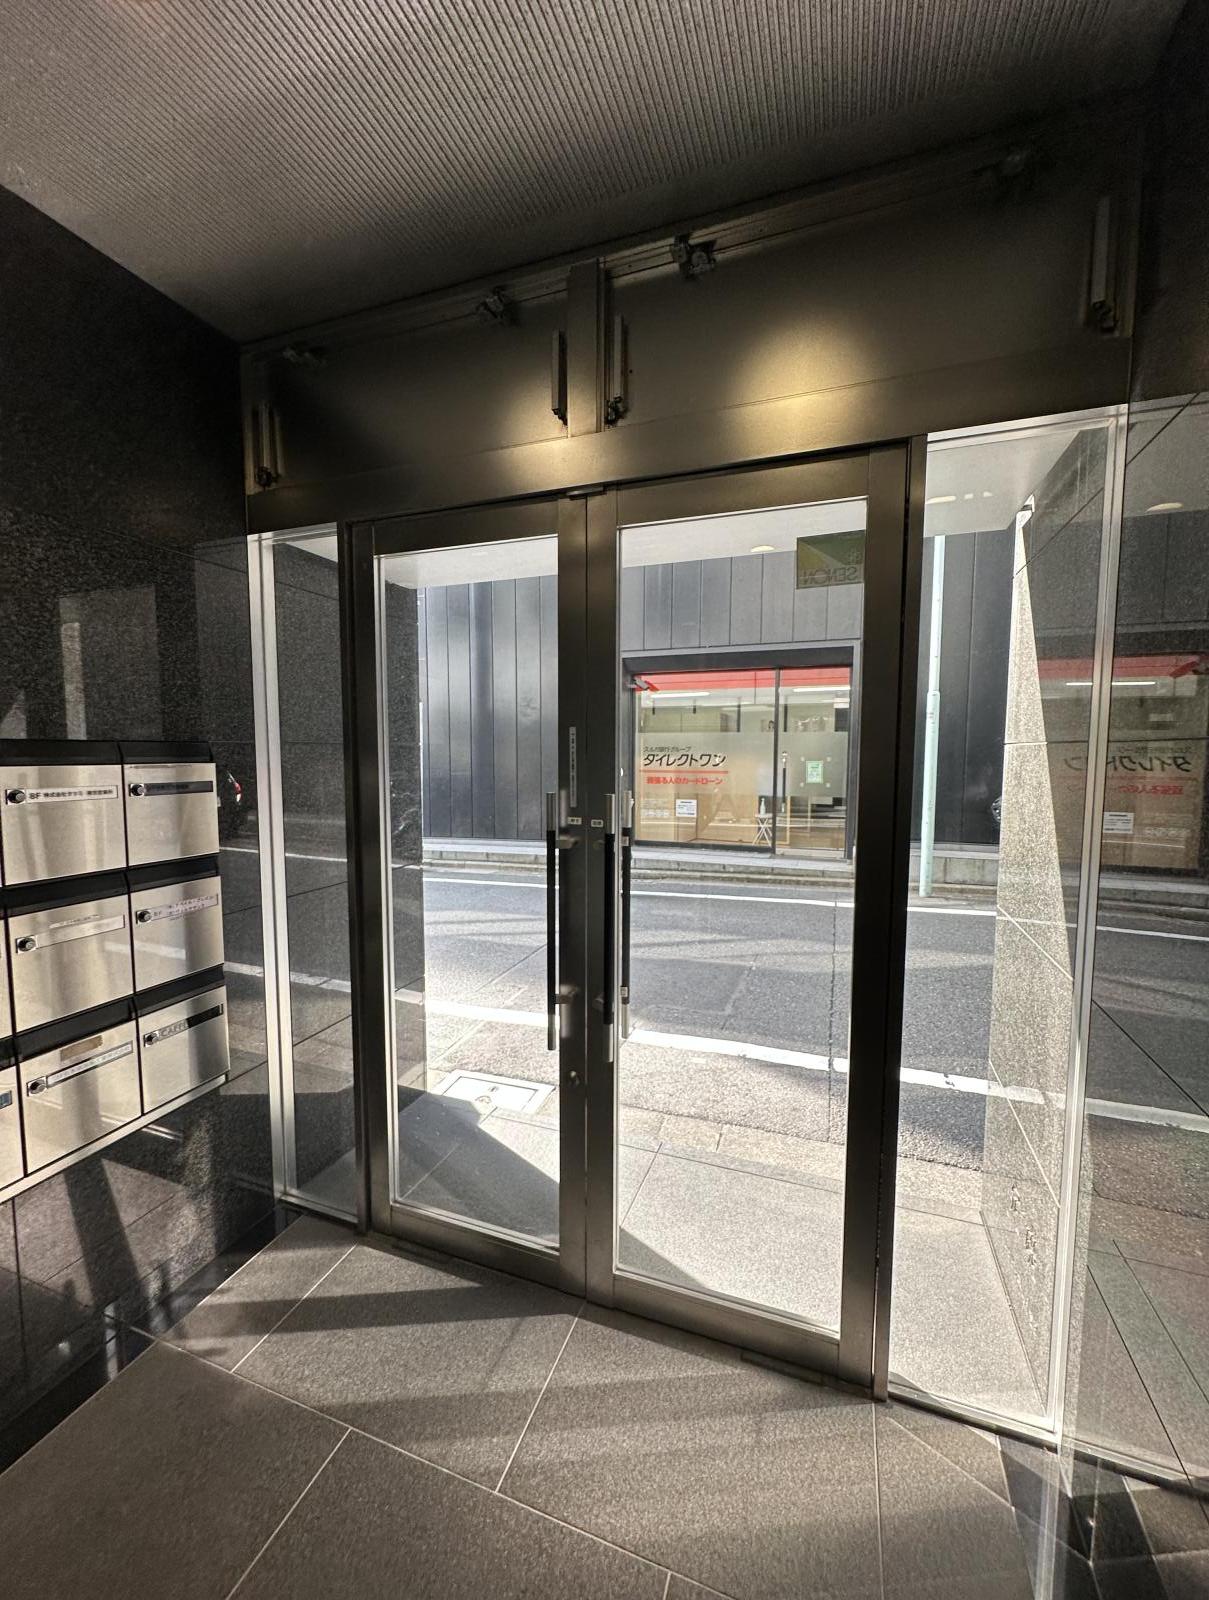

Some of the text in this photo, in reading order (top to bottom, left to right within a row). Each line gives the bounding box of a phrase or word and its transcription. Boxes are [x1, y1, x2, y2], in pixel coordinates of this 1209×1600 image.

[643, 753, 727, 767] ダイレクトワン
